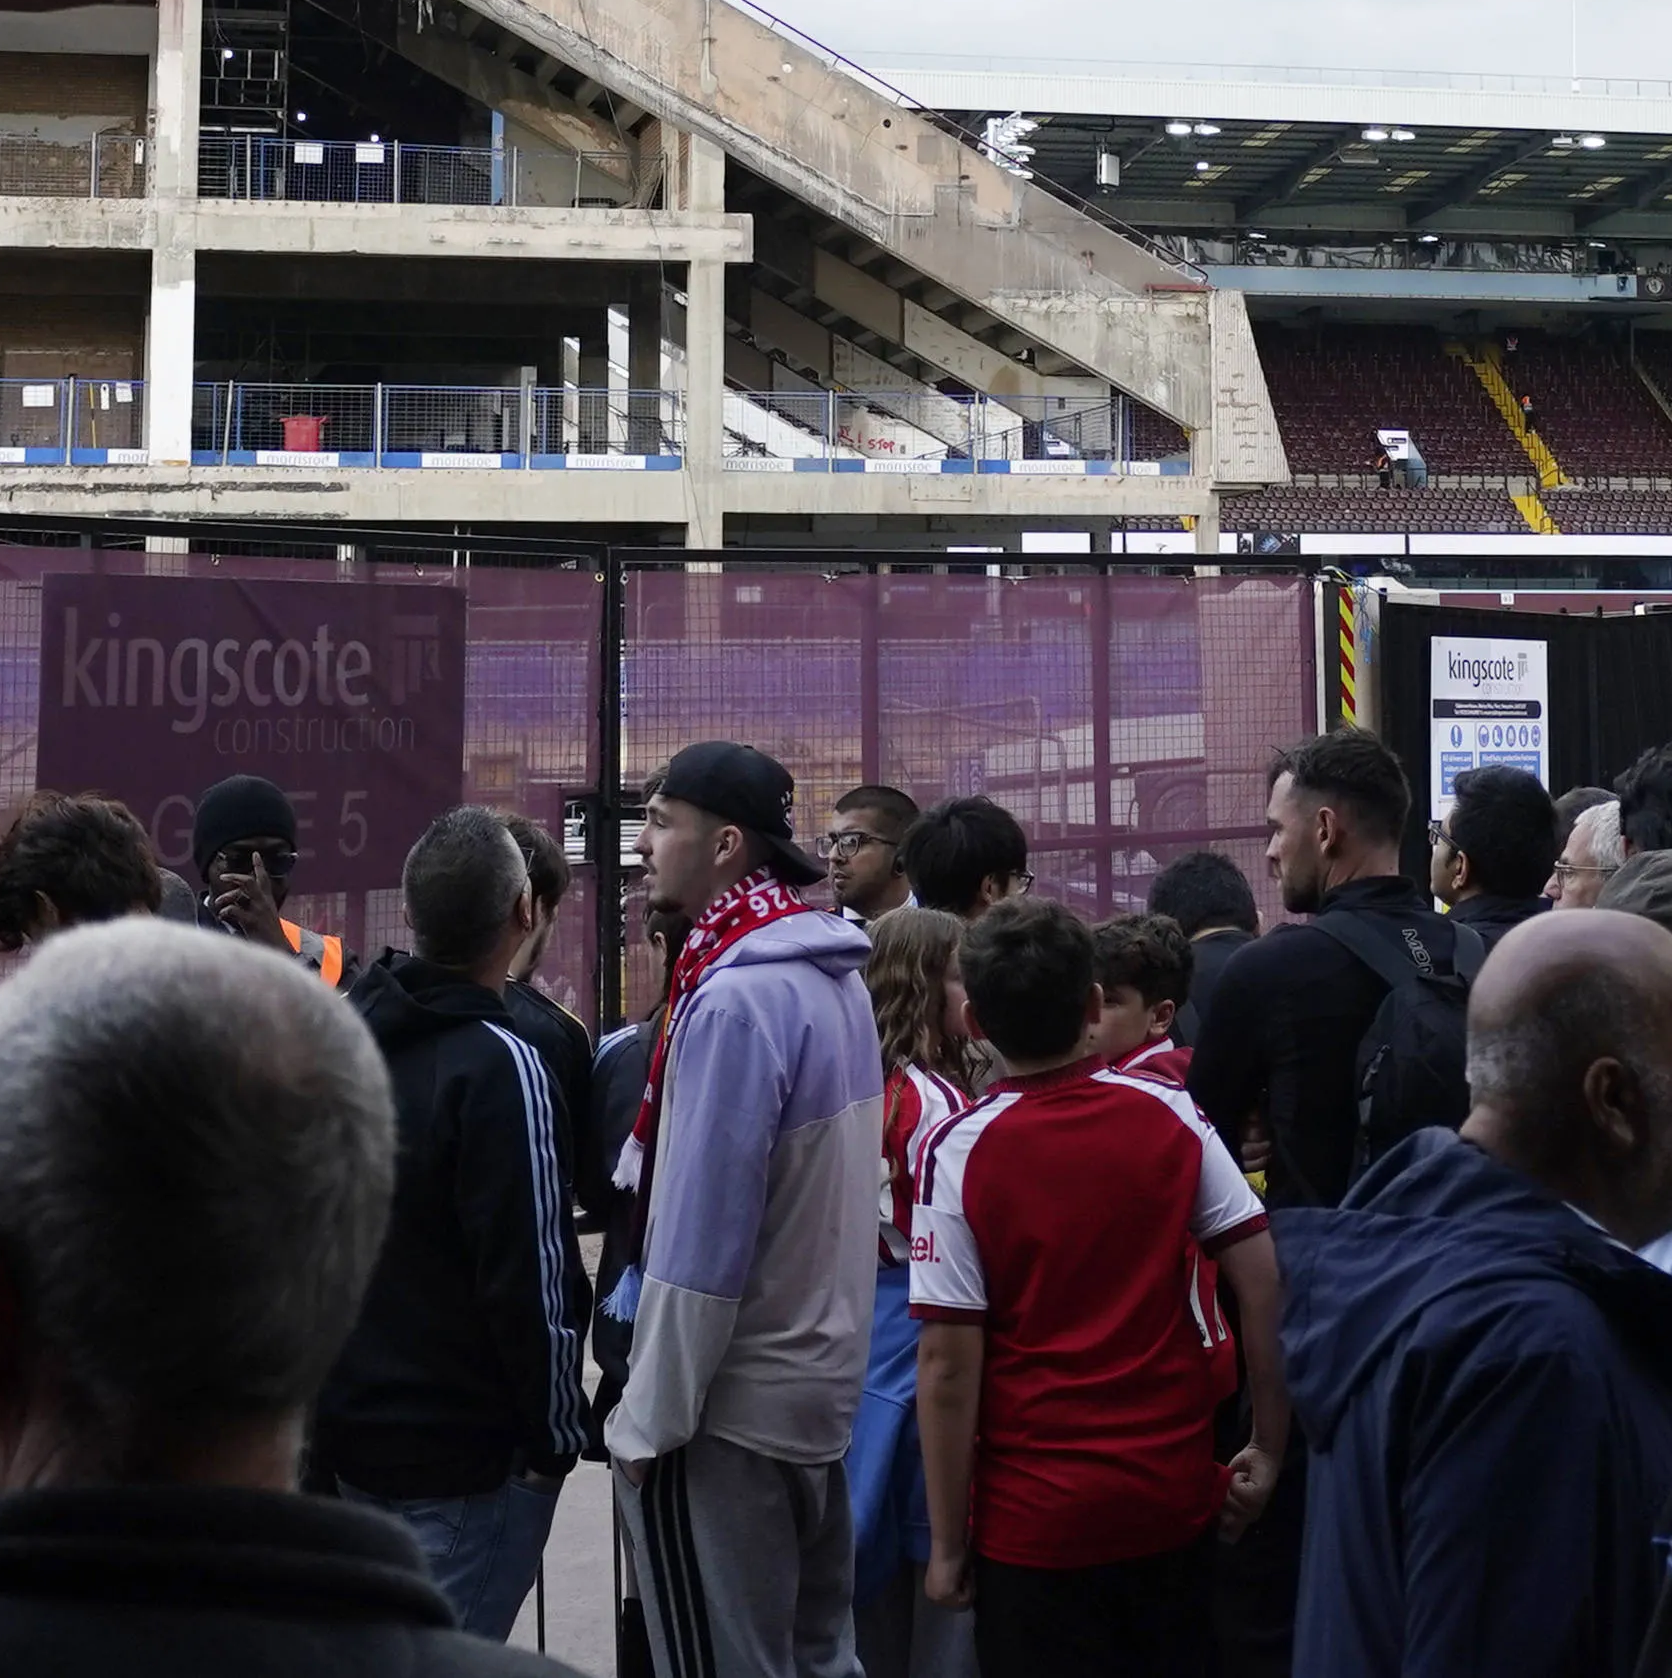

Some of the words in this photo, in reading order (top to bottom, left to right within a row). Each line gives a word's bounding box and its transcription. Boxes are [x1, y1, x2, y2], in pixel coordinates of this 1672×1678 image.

[868, 438, 896, 454] STOP
[430, 454, 492, 467] morrisroe
[575, 456, 637, 468] morrisroe
[725, 459, 785, 470] morrisroe
[873, 460, 933, 471] morrisroe
[1018, 461, 1077, 473] morrisroe
[60, 606, 372, 734] kingscote
[1447, 650, 1515, 687] kingscote
[213, 712, 416, 756] construction
[151, 790, 318, 867] GE
[337, 790, 370, 858] 5
